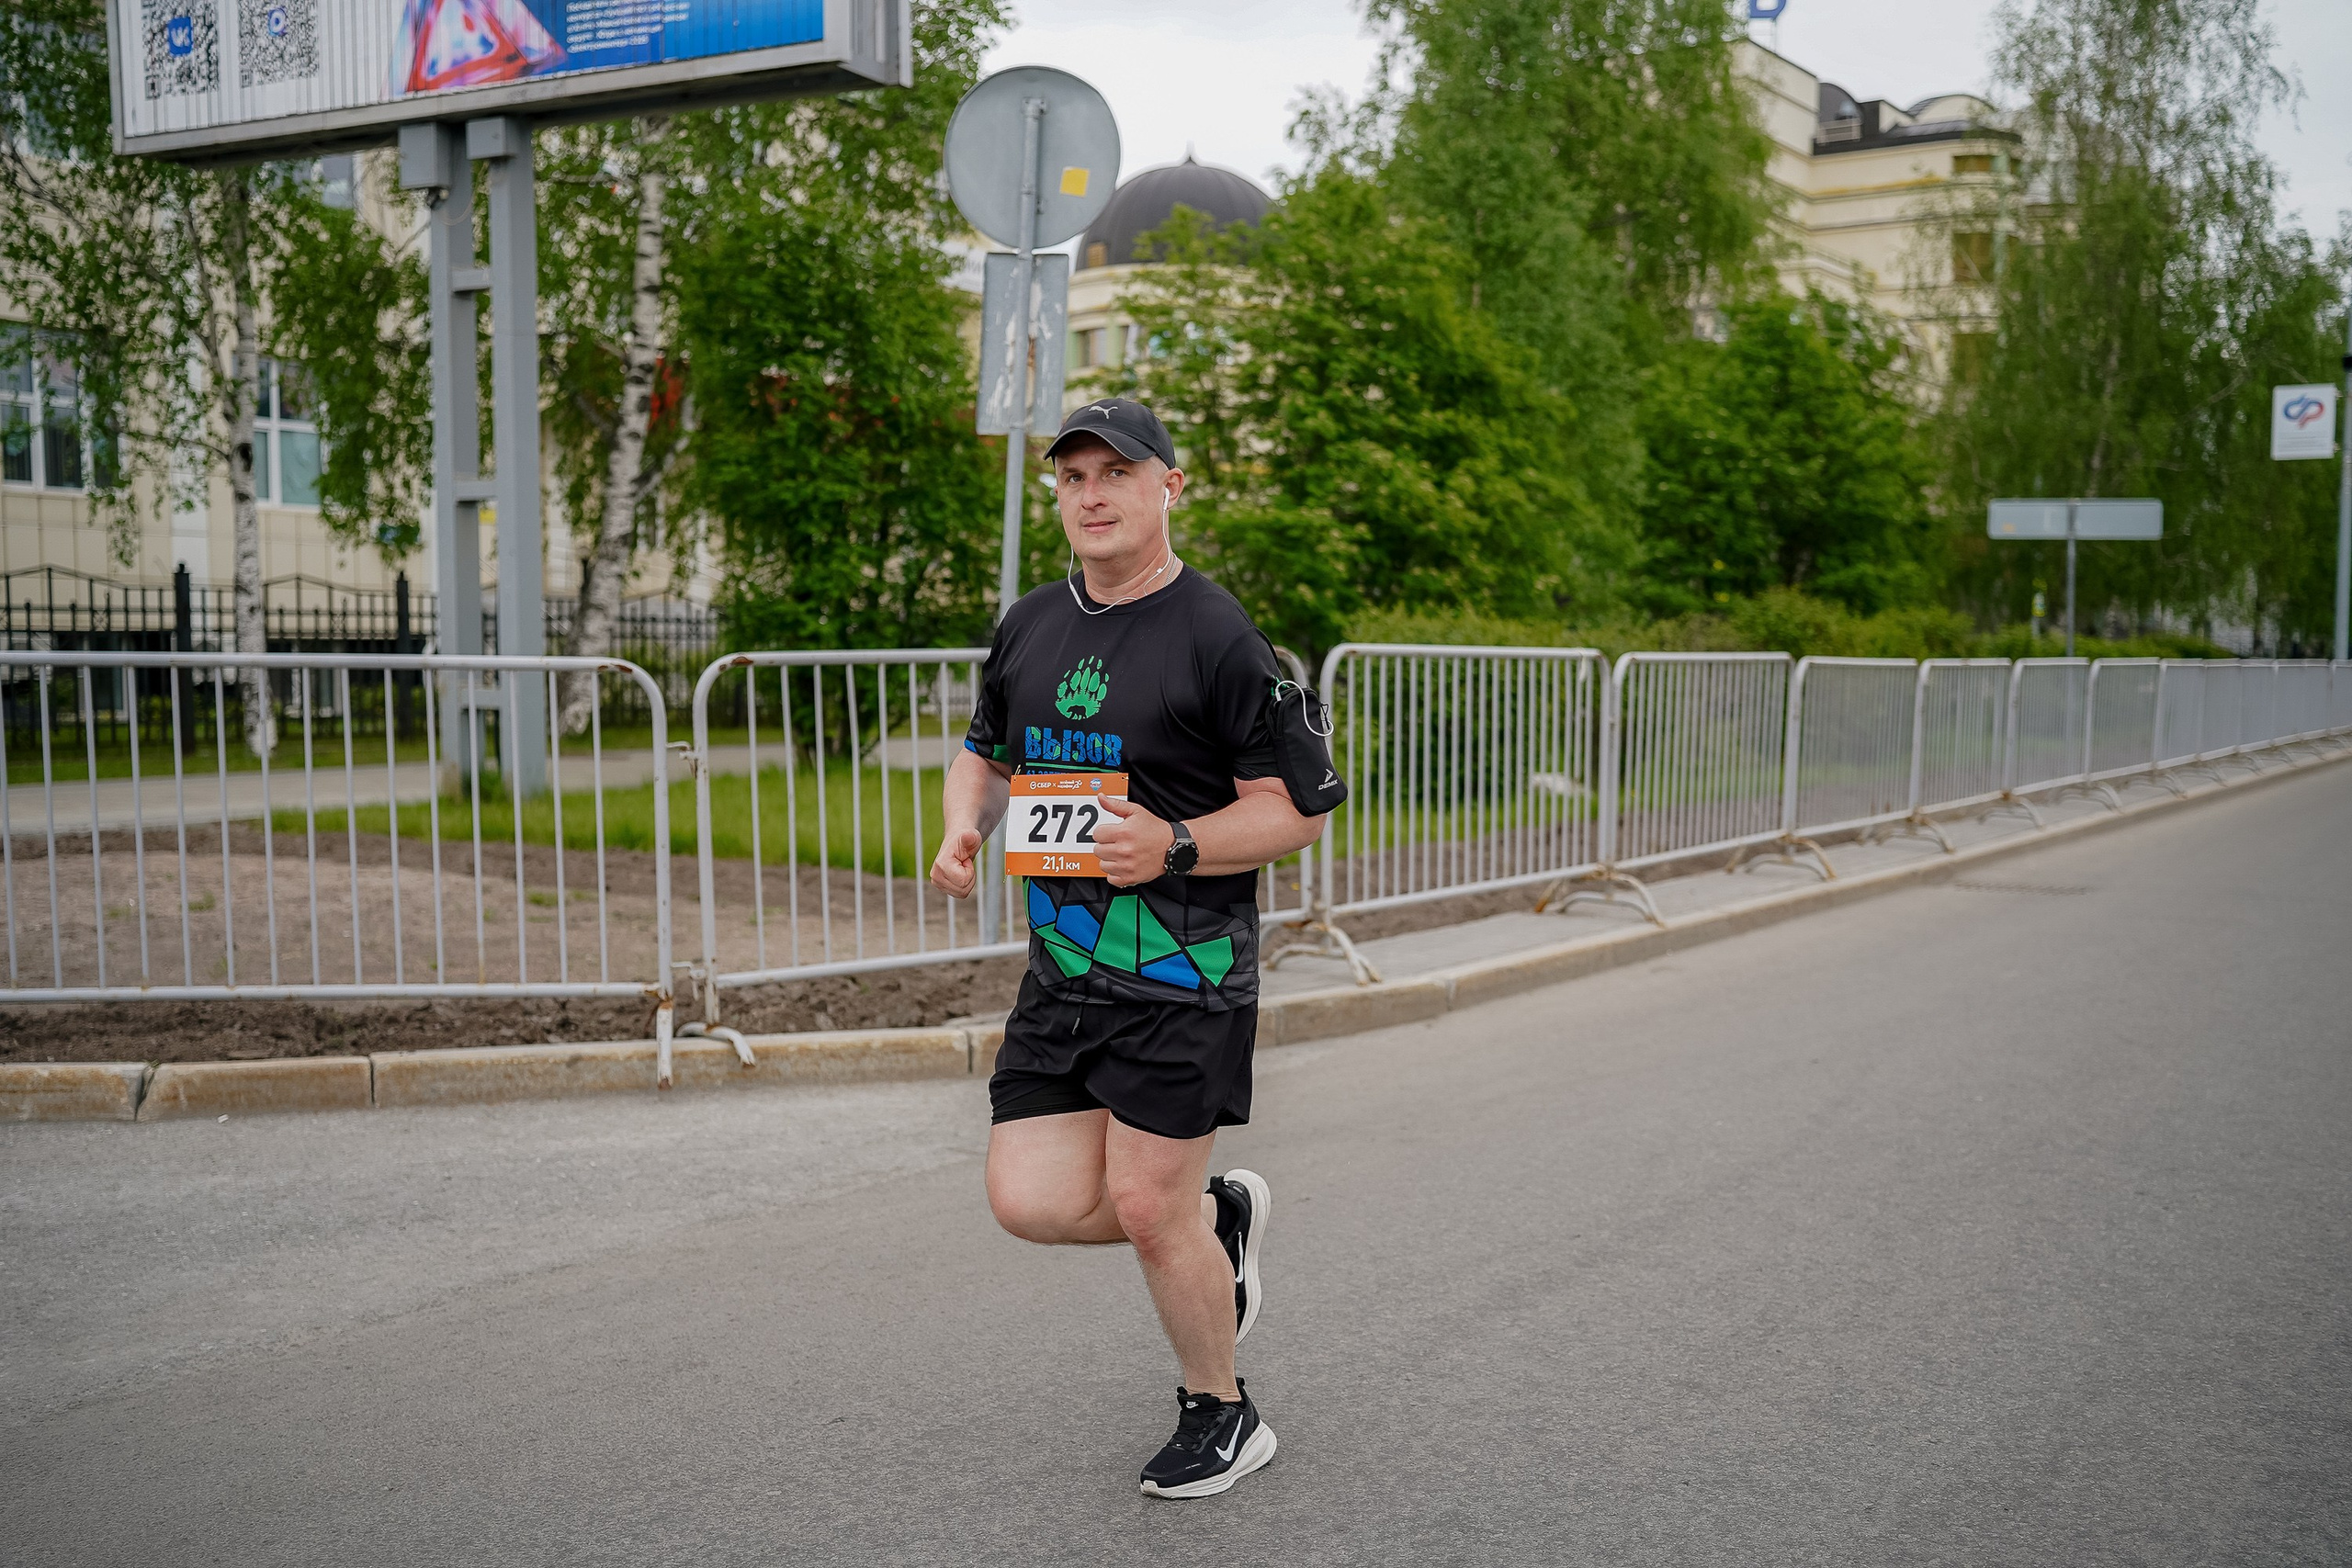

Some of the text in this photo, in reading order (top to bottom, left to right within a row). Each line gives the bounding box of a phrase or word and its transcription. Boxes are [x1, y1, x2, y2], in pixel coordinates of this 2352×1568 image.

[1024, 726, 1123, 767] ВЫЗОВ
[1028, 804, 1099, 843] 272
[1042, 855, 1065, 873] 21,1
